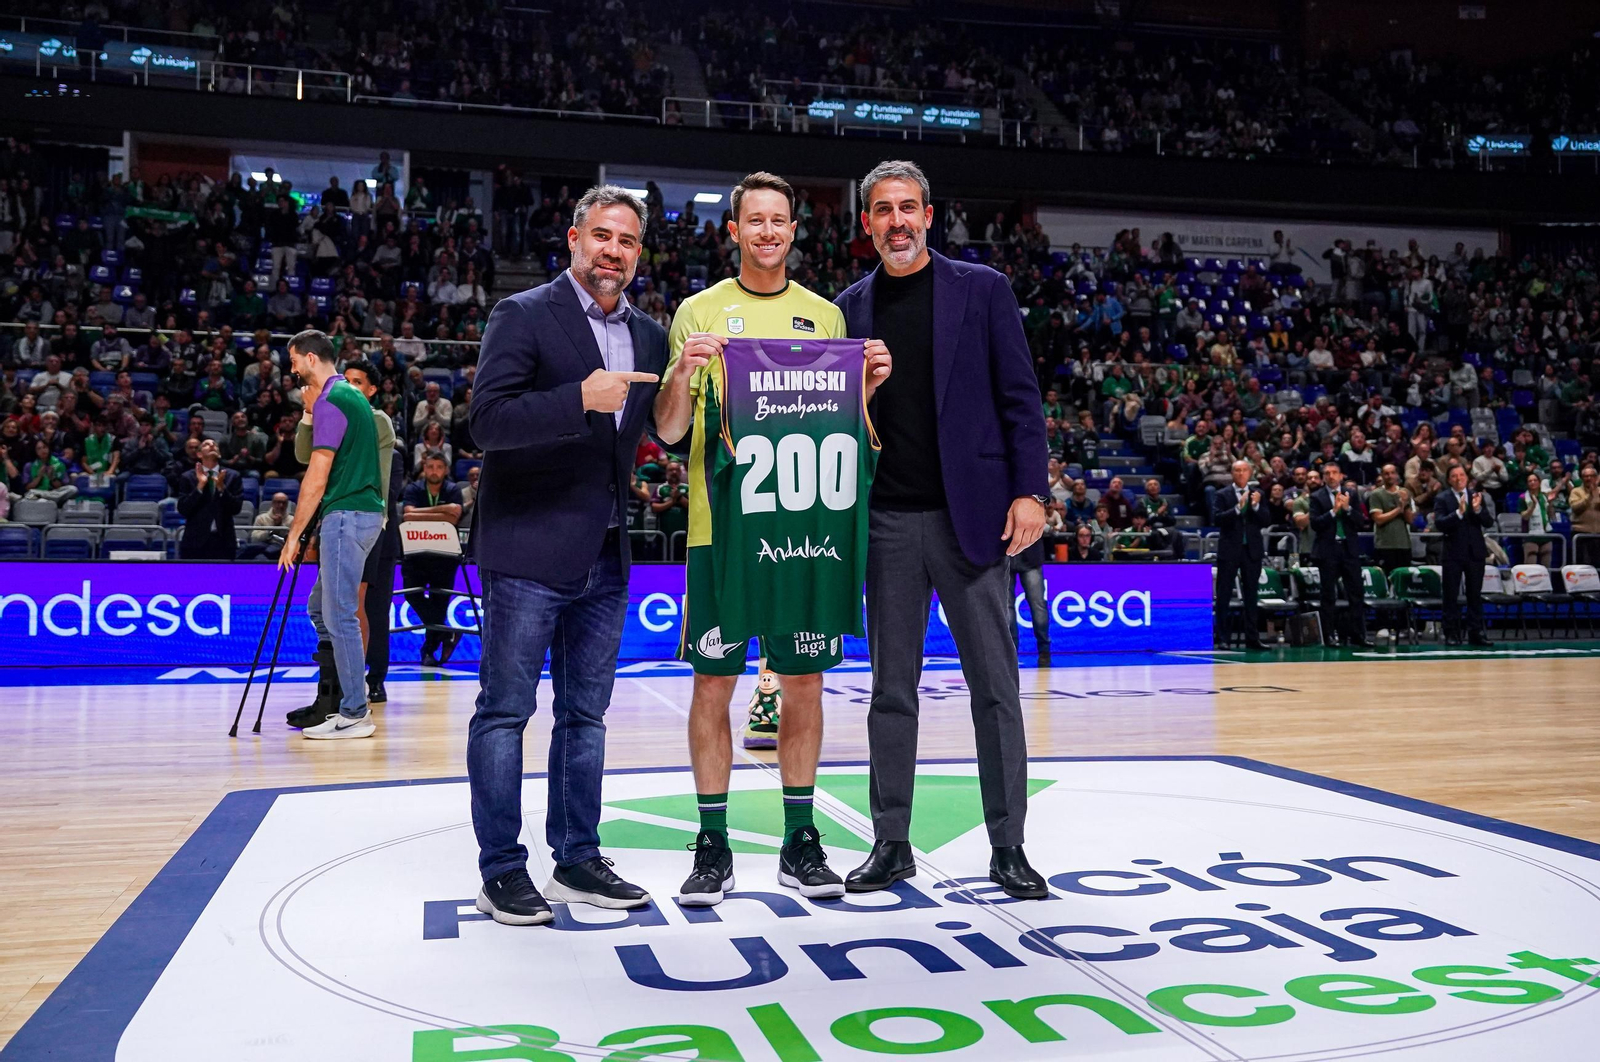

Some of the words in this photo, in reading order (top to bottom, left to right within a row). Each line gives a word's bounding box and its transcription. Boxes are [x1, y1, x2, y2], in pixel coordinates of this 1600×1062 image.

[1570, 140, 1600, 152] Unica
[749, 371, 846, 392] KALINOSKI
[735, 433, 858, 515] 200
[406, 530, 448, 541] Wilson
[613, 902, 1479, 992] Unicaja
